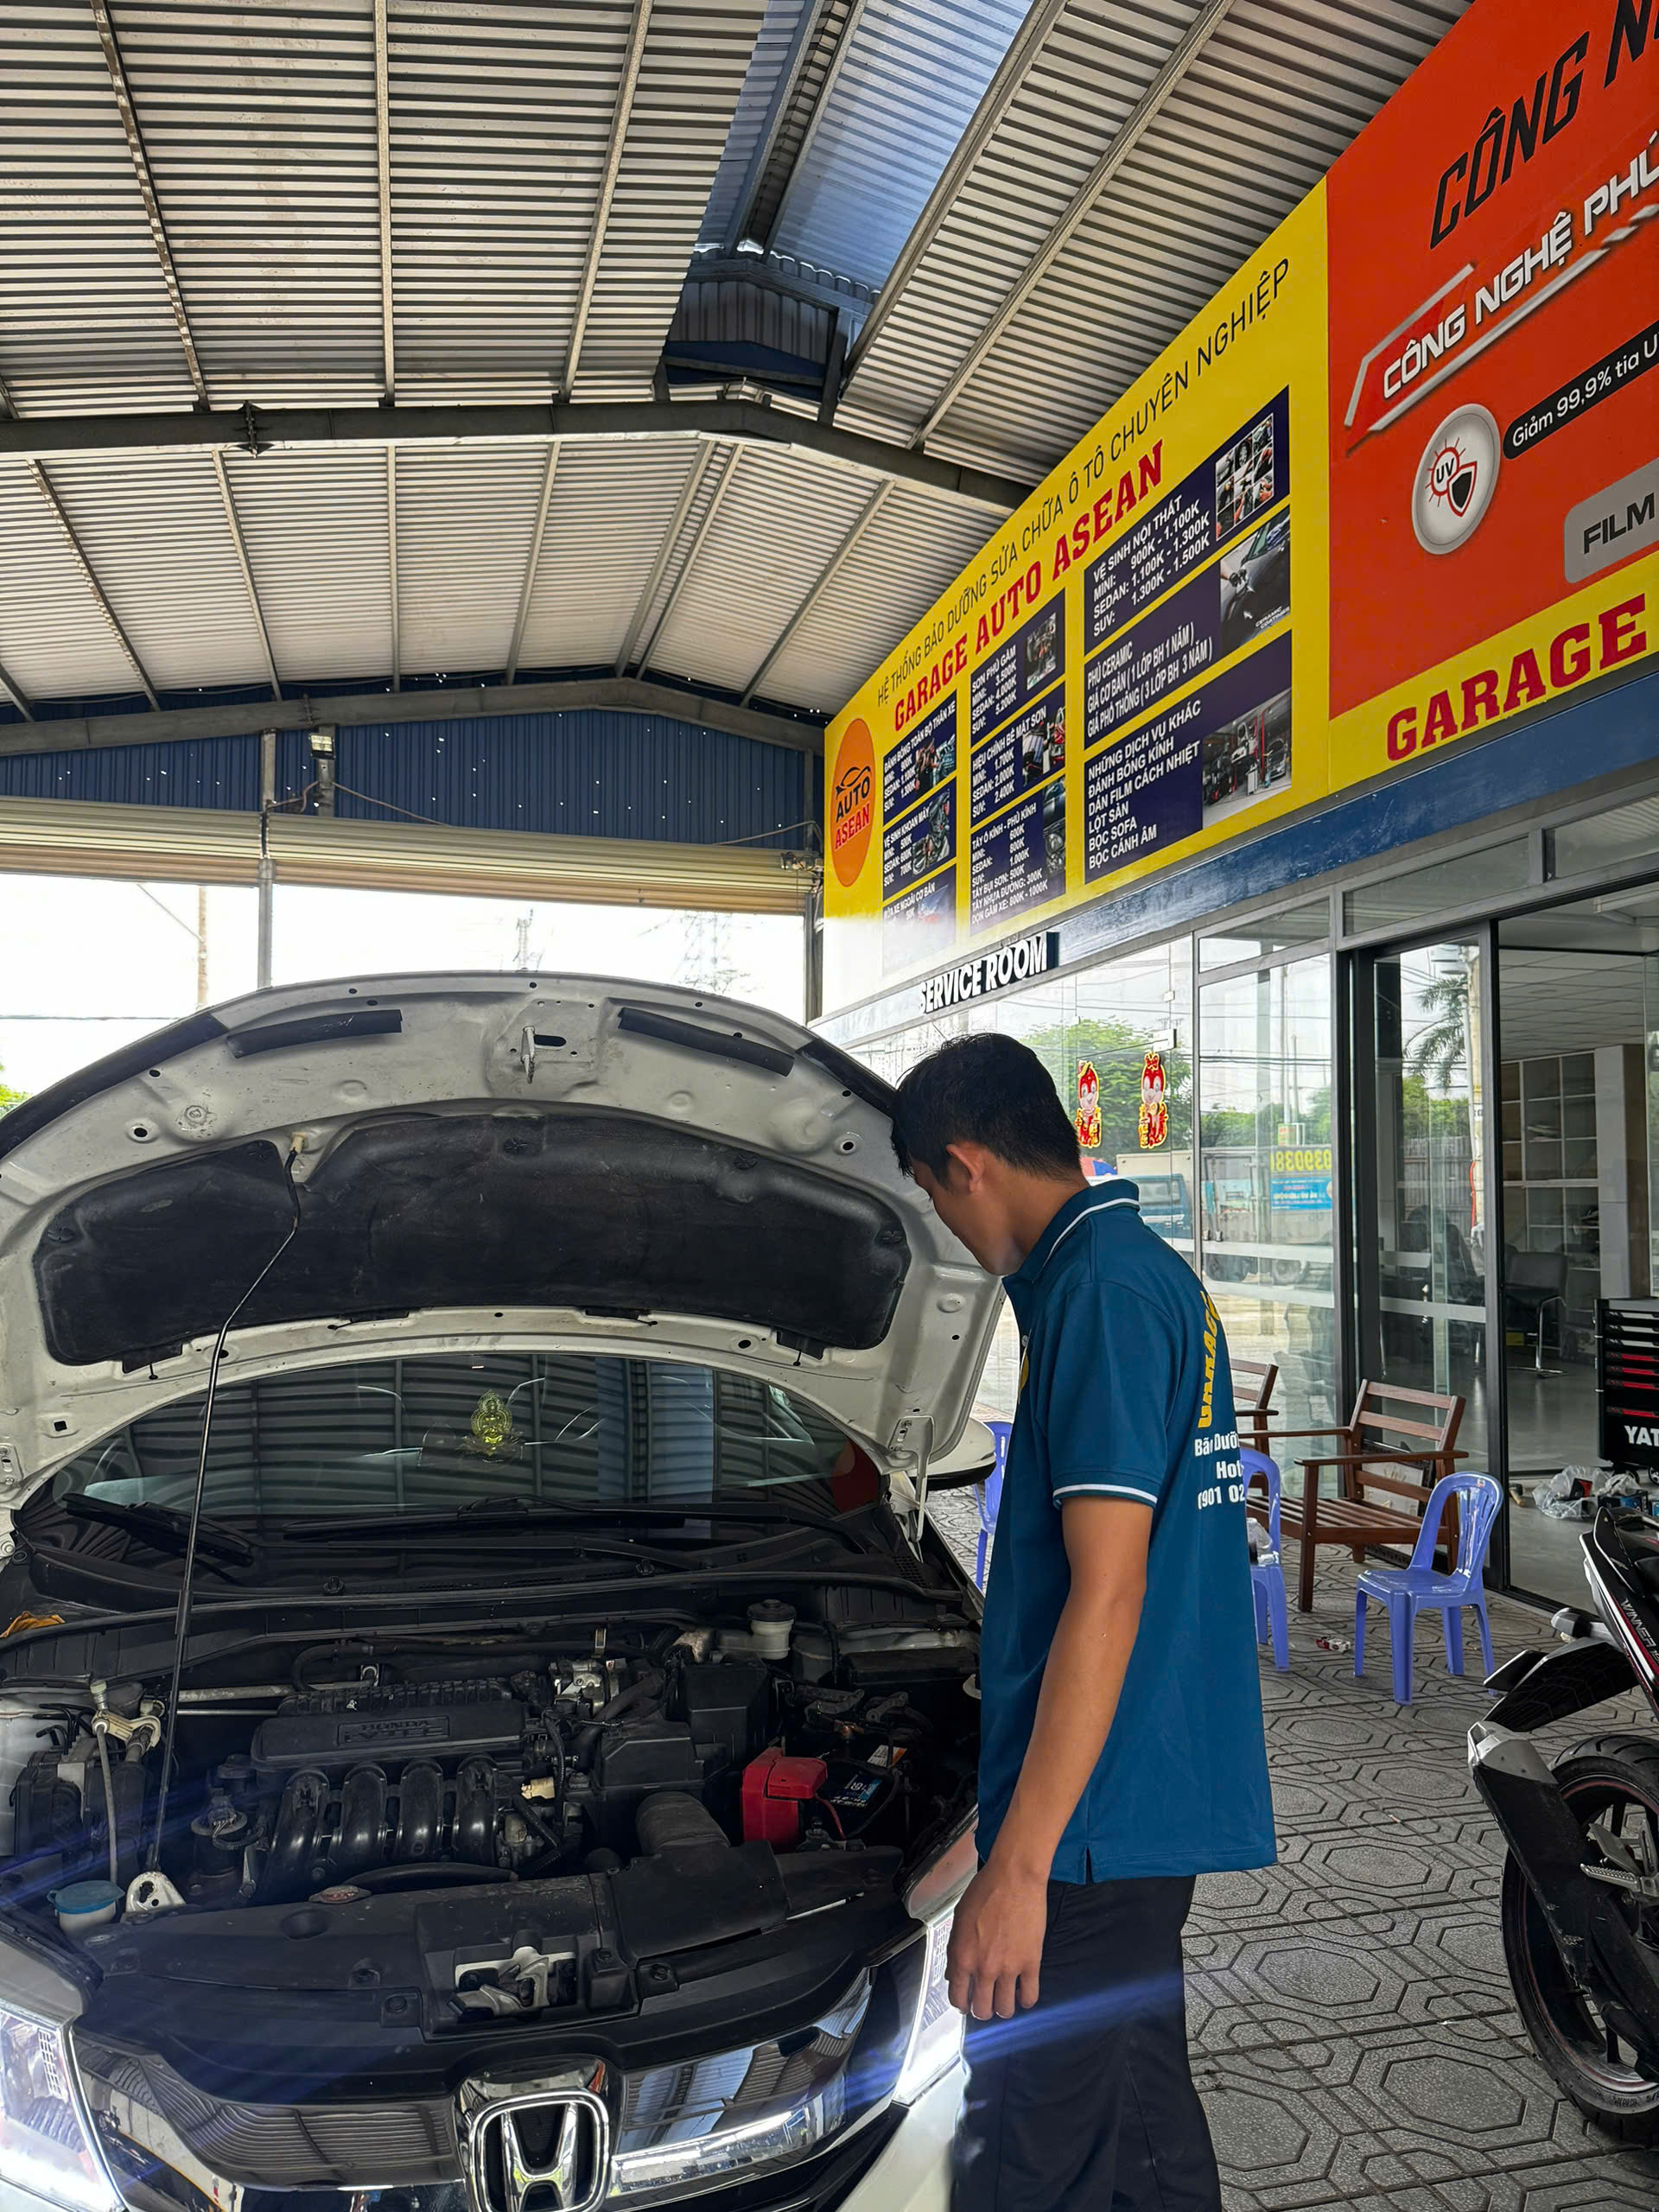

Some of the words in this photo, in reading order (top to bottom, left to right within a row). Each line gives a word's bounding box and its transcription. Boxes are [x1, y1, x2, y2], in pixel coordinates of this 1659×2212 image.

[1429, 30, 1590, 250] CÔNG
[1603, 0, 1659, 89] N
[1383, 303, 1465, 399] CÔNG
[1475, 211, 1573, 325] NGHỆ
[1512, 411, 1553, 447] Giảm
[1556, 366, 1612, 417] 99,9%
[1615, 351, 1639, 378] tia
[1643, 331, 1659, 359] U
[878, 677, 889, 707] HỆ
[892, 646, 922, 691] THỐNG
[925, 621, 944, 658] BẢO
[948, 574, 987, 633] DƯỠNG
[991, 542, 1018, 585] SỬA
[1022, 494, 1064, 551] CHỮA
[1069, 472, 1078, 504] Ô
[1084, 445, 1104, 488] TÔ
[1111, 360, 1189, 461] CHUYÊN
[1198, 257, 1289, 377] NGHIỆP
[1435, 457, 1455, 484] UV
[1093, 562, 1106, 583] VỆ
[1108, 540, 1131, 571] SINH
[1133, 523, 1151, 550] NỘI
[1153, 495, 1182, 531] THẤT
[1093, 574, 1116, 602] MINI:
[1130, 537, 1155, 569] 900K
[1164, 499, 1199, 541] 1.100K
[1093, 582, 1129, 620] SEDAN:
[1131, 549, 1165, 588] 1.100K
[1173, 510, 1210, 552] 1.300K
[1583, 492, 1656, 555] FILM
[894, 632, 968, 732] GARAGE
[976, 561, 1041, 655] AUTO
[1052, 438, 1163, 582] ASEAN
[1093, 610, 1116, 638] SUV:
[1131, 569, 1165, 606] 1.300K
[1173, 531, 1210, 572] 1.500K
[1087, 687, 1100, 714] GIÁ
[1112, 671, 1126, 697] BẢN
[1136, 652, 1153, 679] LỚP
[1153, 643, 1164, 668] BH
[1171, 624, 1190, 654] NĂM
[1087, 711, 1100, 738] GIÁ
[1115, 687, 1140, 719] THÔNG
[1150, 667, 1166, 696] LỚP
[1167, 658, 1179, 684] BH
[1189, 639, 1207, 670] NĂM
[1102, 641, 1133, 679] CERAMIC
[1387, 593, 1647, 761] GARAGE
[972, 695, 995, 721] SEDAN:
[972, 715, 986, 734] SUV:
[1088, 749, 1122, 782] NHỮNG
[1124, 733, 1149, 759] DỊCH
[1151, 722, 1166, 742] VỤ
[1168, 699, 1201, 733] KHÁC
[836, 776, 870, 823] AUTO
[972, 779, 994, 802] SEDAN:
[1088, 771, 1115, 798] ĐÁNH
[1116, 755, 1146, 783] BÓNG
[1147, 736, 1174, 764] KÍNH
[1088, 791, 1108, 817] DÁN
[1110, 781, 1133, 804] FILM
[1135, 764, 1164, 791] CÁCH
[1166, 741, 1200, 773] NHIỆT
[835, 802, 870, 849] ASEAN
[1089, 830, 1109, 852] BỌC
[1111, 816, 1137, 840] SOFA
[1089, 849, 1109, 869] BỌC
[1111, 834, 1138, 858] CÁNH
[1141, 824, 1157, 846] ÂM
[918, 962, 982, 1014] SERVICE
[986, 931, 1048, 991] ROOM
[1214, 1431, 1240, 1452] Dưỡ
